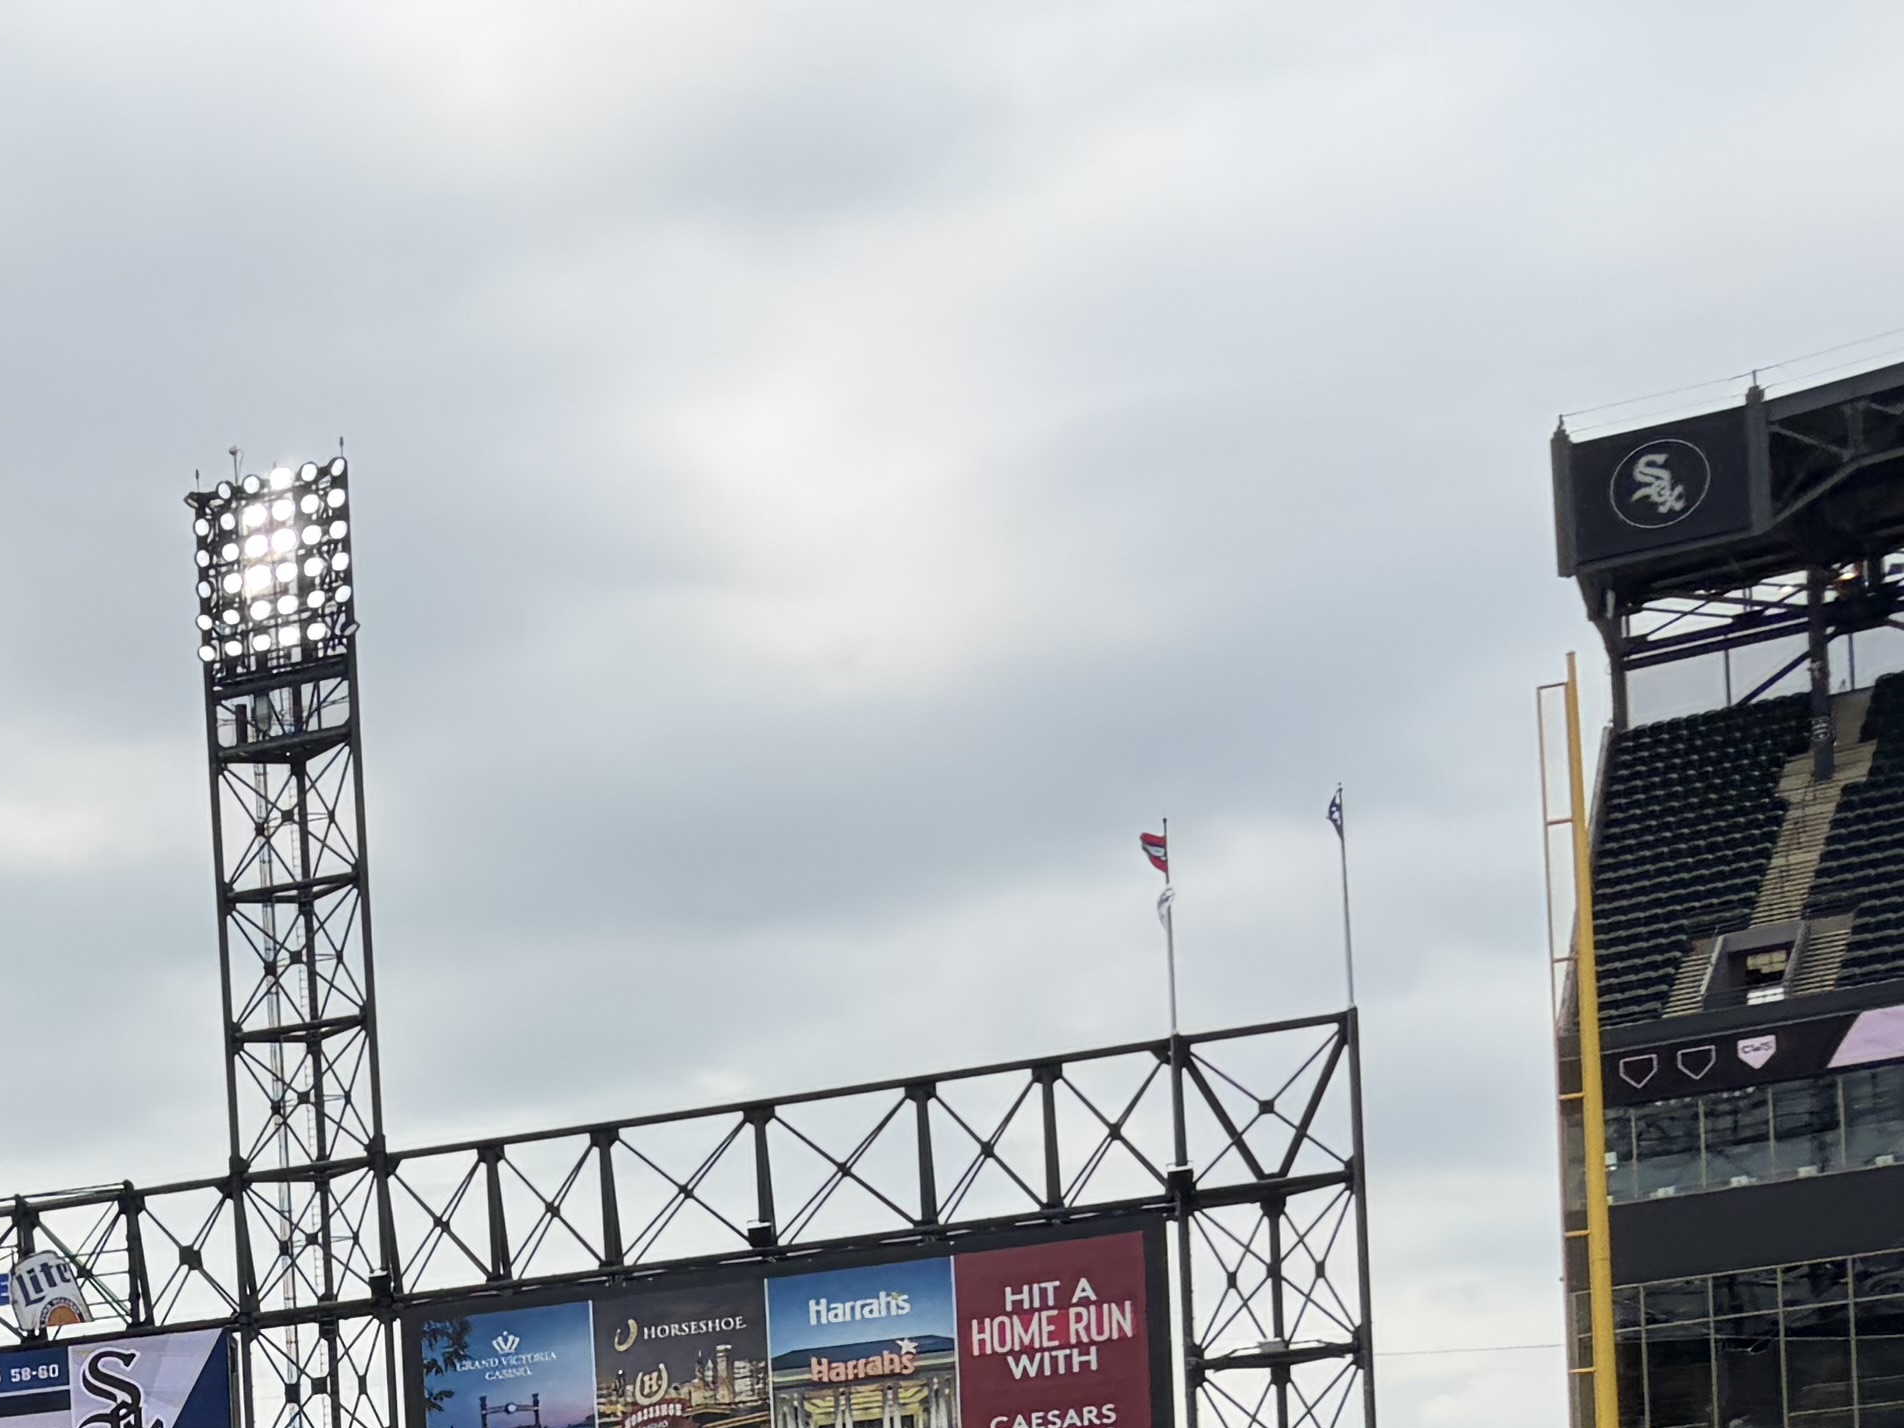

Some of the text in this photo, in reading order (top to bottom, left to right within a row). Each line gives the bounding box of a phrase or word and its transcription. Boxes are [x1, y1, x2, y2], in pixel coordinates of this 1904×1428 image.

[17, 1262, 72, 1307] Lite
[1005, 1278, 1098, 1312] HIT A
[643, 1316, 747, 1341] HORSESHOE
[971, 1300, 1133, 1356] HOME RUN
[10, 1364, 59, 1383] 58-60
[1006, 1346, 1098, 1380] WITH
